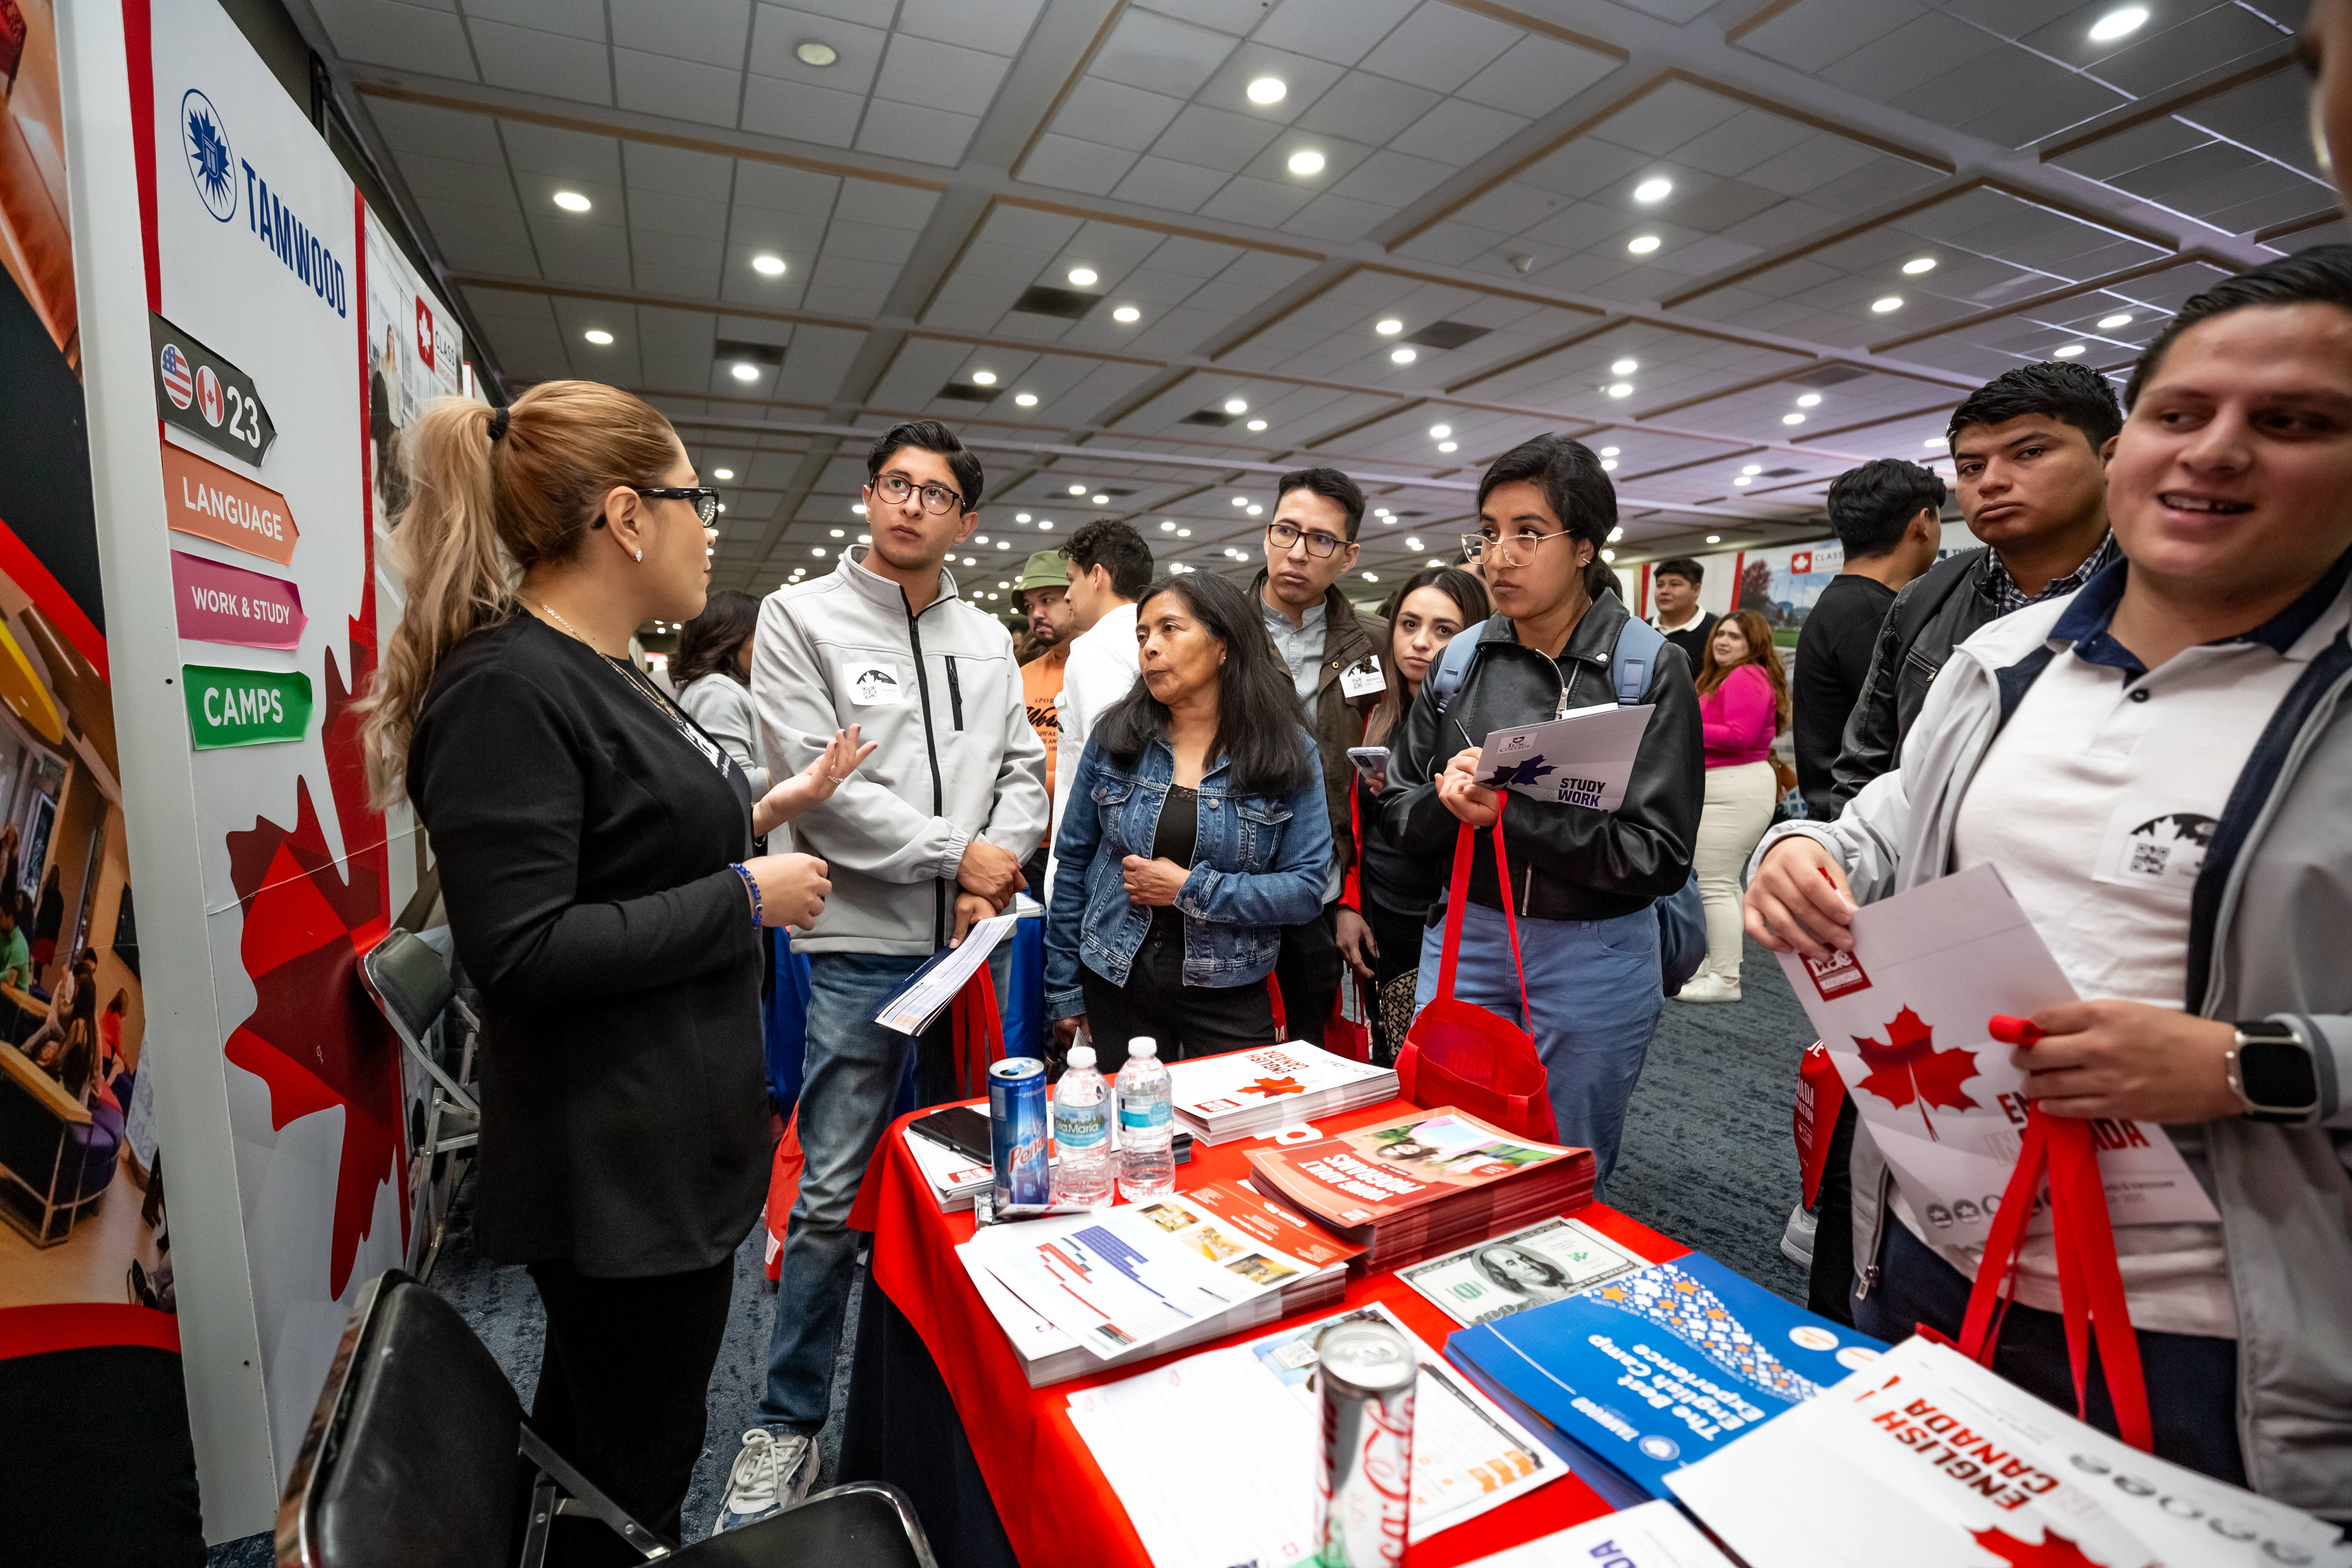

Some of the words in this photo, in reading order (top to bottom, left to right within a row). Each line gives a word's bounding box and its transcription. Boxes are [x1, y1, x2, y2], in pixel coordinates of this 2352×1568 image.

[241, 157, 346, 318] TAMWOOD
[435, 331, 454, 366] CLASS
[226, 386, 261, 448] 23
[183, 476, 283, 542] LANGUAGE
[191, 585, 239, 617] WORK
[242, 597, 250, 618] &
[253, 599, 290, 625] STUDY
[204, 687, 283, 727] CAMPS
[1558, 789, 1602, 807] WORK
[1560, 778, 1606, 794] STUDY
[1244, 1054, 1292, 1074] ENGLISH
[1262, 1050, 1309, 1070] CANADA
[1298, 1161, 1352, 1185] ADULT
[1323, 1154, 1427, 1195] PROGRAMS
[1337, 1180, 1394, 1202] YOUNG
[1588, 1334, 1652, 1377] Camp
[1617, 1373, 1674, 1409] Best
[1632, 1344, 1765, 1422] Experience
[1651, 1373, 1745, 1431] English
[1571, 1396, 1639, 1442] TAMWOOD
[1672, 1405, 1721, 1441] The
[1872, 1410, 2031, 1512] ENGLISH
[1903, 1397, 2059, 1494] CANADA
